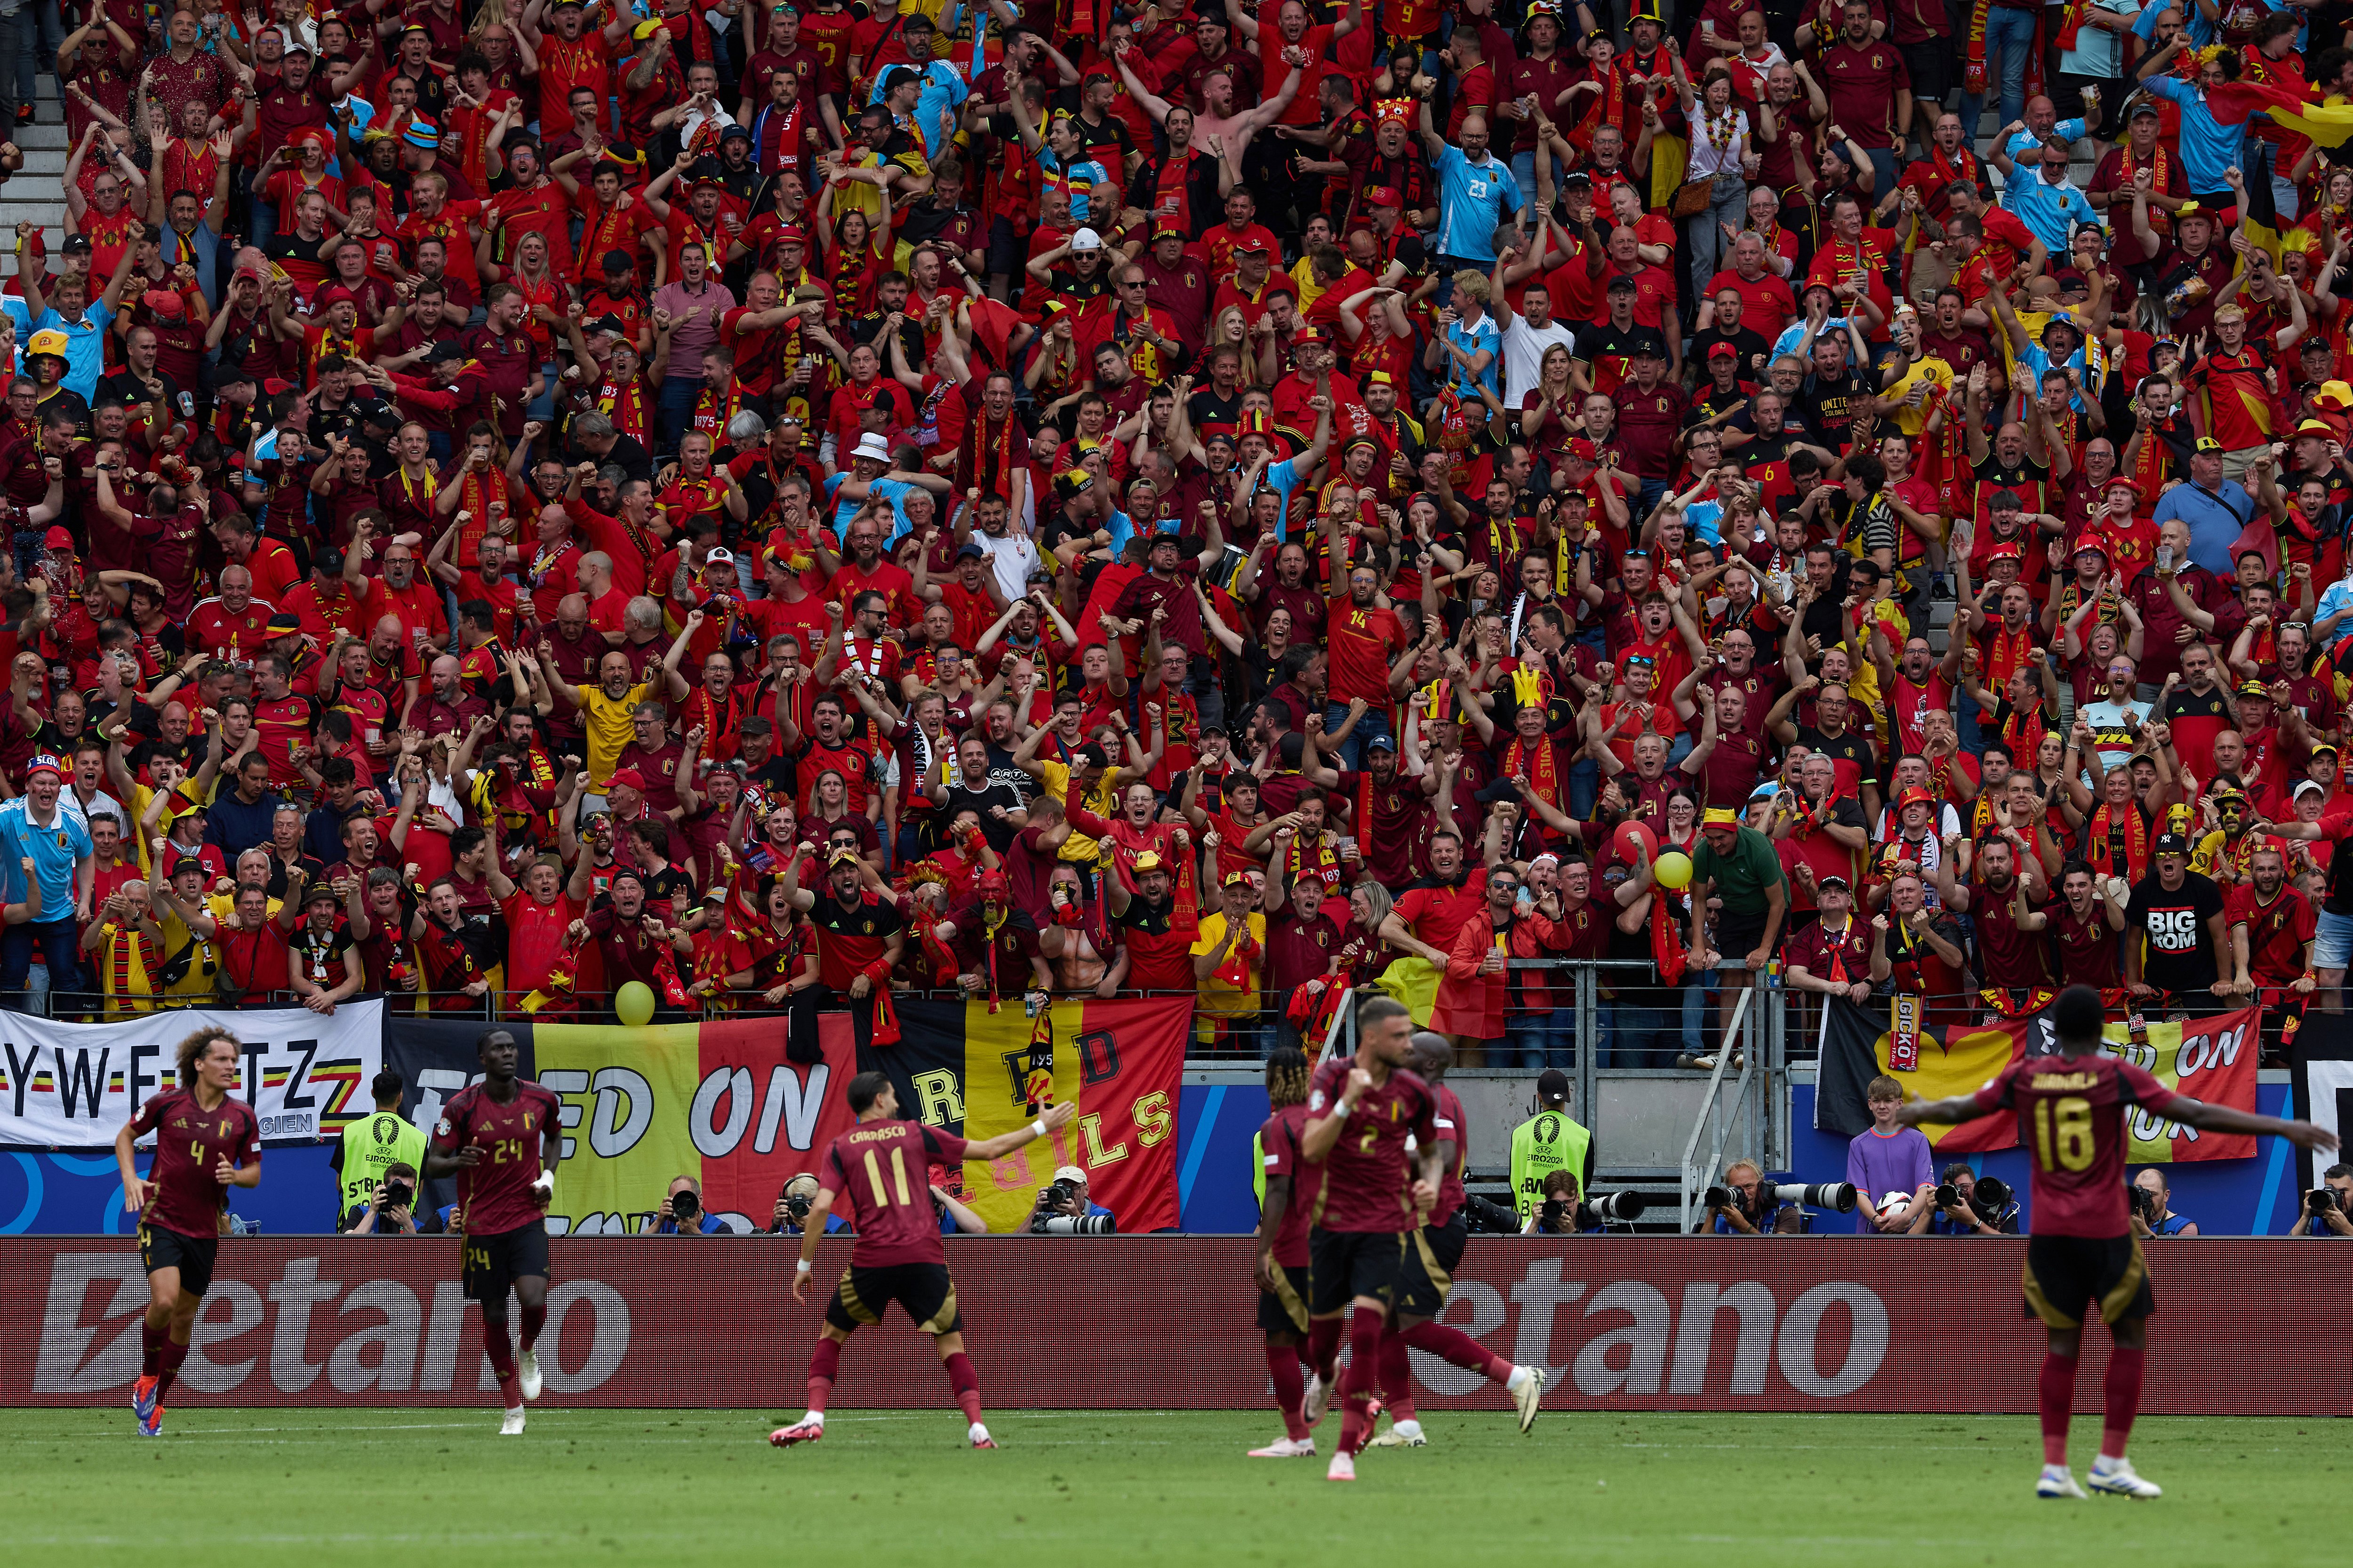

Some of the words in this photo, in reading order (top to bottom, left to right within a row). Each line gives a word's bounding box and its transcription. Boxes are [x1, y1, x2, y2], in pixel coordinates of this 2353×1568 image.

[1401, 5, 1413, 23] 9
[816, 29, 843, 38] PALUCH
[2157, 162, 2166, 187] EURO
[1469, 179, 1487, 199] 23
[1576, 241, 1583, 255] 7
[1077, 299, 1086, 317] 7
[1619, 357, 1629, 377] 7
[1825, 408, 1844, 417] COLORS
[716, 421, 724, 439] 7
[1765, 465, 1774, 481] 6
[1223, 501, 1232, 518] 7
[1505, 546, 1513, 565] 7
[1351, 610, 1366, 629] 14
[230, 631, 237, 648] 4
[2094, 683, 2109, 696] 10
[2102, 727, 2126, 744] 22
[61, 754, 73, 772] 10
[1644, 799, 1657, 816] 21
[2161, 834, 2171, 843] NY
[823, 841, 830, 859] 7
[2148, 911, 2195, 933] BIG
[2153, 933, 2196, 950] ROM
[465, 954, 472, 972] 6
[776, 953, 787, 973] 3
[2174, 1024, 2247, 1078] ON
[689, 1062, 831, 1159] ON
[848, 1125, 907, 1145] CARRASCO
[1360, 1124, 1380, 1155] 2
[2034, 1096, 2096, 1174] 18
[191, 1140, 205, 1166] 4
[495, 1137, 523, 1164] 24
[1527, 1153, 1563, 1166] EURO2024
[1535, 1147, 1552, 1155] UEFA
[863, 1145, 912, 1208] 11
[467, 1247, 491, 1272] 24
